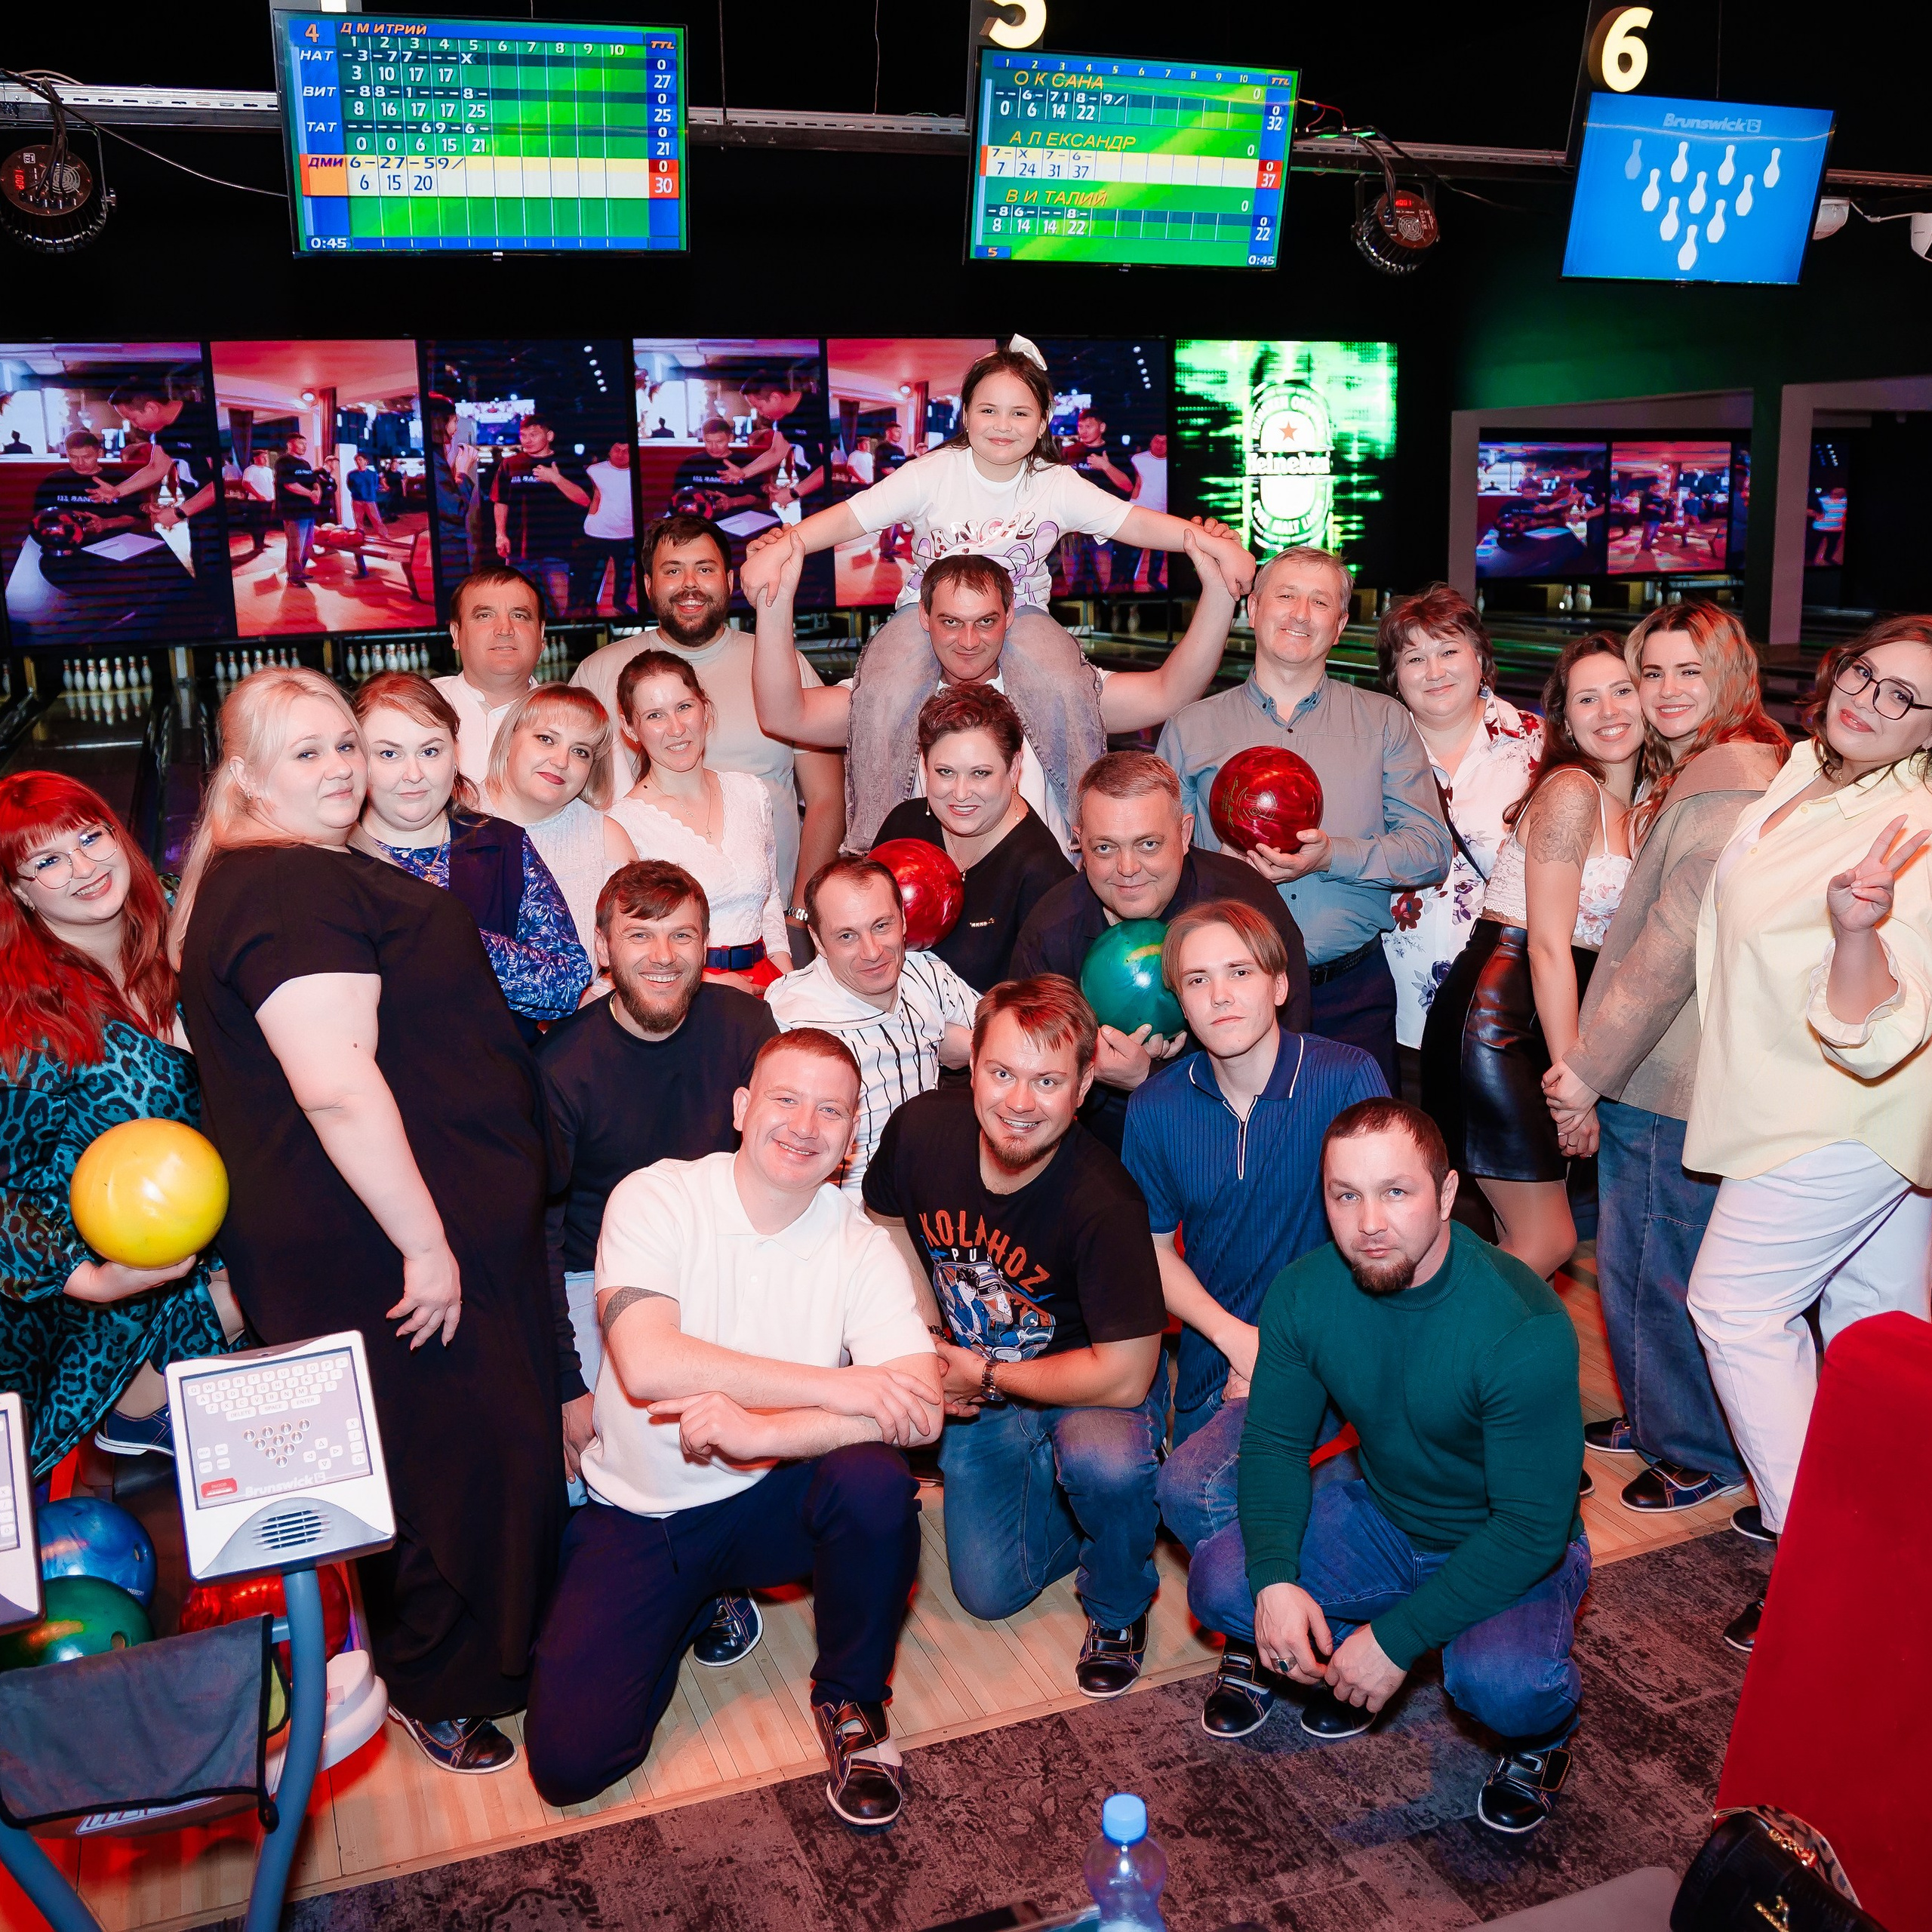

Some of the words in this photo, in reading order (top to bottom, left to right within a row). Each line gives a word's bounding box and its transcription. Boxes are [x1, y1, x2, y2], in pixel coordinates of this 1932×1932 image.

[304, 23, 319, 43] 4
[352, 36, 357, 47] 1
[380, 36, 389, 48] 2
[410, 38, 420, 48] 3
[439, 38, 450, 50] 4
[469, 40, 478, 51] 5
[498, 41, 508, 52] 6
[528, 42, 537, 52] 7
[555, 42, 565, 53] 8
[583, 43, 593, 54] 9
[610, 45, 624, 56] 10
[651, 40, 675, 50] TTL
[1600, 7, 1653, 92] 6
[300, 50, 334, 61] НАТ
[657, 59, 666, 71] 0
[352, 66, 361, 80] 3
[378, 66, 395, 81] 10
[409, 67, 424, 82] 17
[438, 68, 454, 83] 17
[654, 75, 671, 89] 27
[1032, 60, 1038, 69] 2
[1060, 62, 1065, 71] 3
[1085, 63, 1092, 72] 4
[1112, 65, 1118, 74] 5
[1138, 67, 1145, 75] 6
[1165, 69, 1171, 78] 7
[1190, 71, 1197, 79] 8
[1216, 72, 1222, 82] 9
[1239, 75, 1248, 83] 10
[1271, 77, 1290, 86] TTL
[303, 86, 337, 97] ВИТ
[657, 94, 667, 104] 0
[1253, 88, 1261, 100] 0
[354, 101, 364, 115] 8
[381, 102, 397, 116] 16
[411, 103, 426, 117] 17
[441, 103, 455, 118] 17
[468, 104, 486, 118] 25
[654, 109, 671, 123] 25
[1001, 100, 1010, 115] 0
[1027, 103, 1037, 117] 6
[1052, 103, 1066, 118] 14
[1076, 106, 1094, 120] 22
[1267, 116, 1282, 131] 32
[1272, 106, 1280, 115] 0
[306, 122, 337, 133] ТАТ
[658, 128, 667, 138] 0
[1663, 112, 1746, 132] Brunswick
[356, 137, 367, 150] 0
[386, 137, 396, 151] 0
[416, 138, 426, 152] 6
[442, 138, 457, 152] 15
[472, 139, 486, 152] 21
[657, 142, 670, 155] 21
[1247, 145, 1255, 156] 0
[308, 156, 343, 168] ДМИ
[659, 161, 668, 172] 0
[1266, 162, 1274, 171] 0
[360, 174, 369, 190] 6
[387, 174, 401, 190] 15
[414, 175, 432, 190] 20
[654, 177, 672, 194] 30
[997, 162, 1005, 174] 7
[1019, 163, 1036, 177] 24
[1048, 164, 1060, 177] 31
[1074, 165, 1089, 179] 37
[1261, 173, 1275, 188] 37
[1241, 200, 1249, 212] 0
[992, 217, 1002, 232] 8
[1017, 219, 1030, 233] 14
[1043, 220, 1057, 234] 14
[1067, 220, 1086, 235] 22
[1255, 226, 1271, 242] 22
[1260, 217, 1268, 226] 0
[310, 237, 347, 249] 0:45
[987, 247, 998, 257] 5
[1248, 255, 1275, 265] 0:45
[245, 1475, 314, 1497] Brunswick
